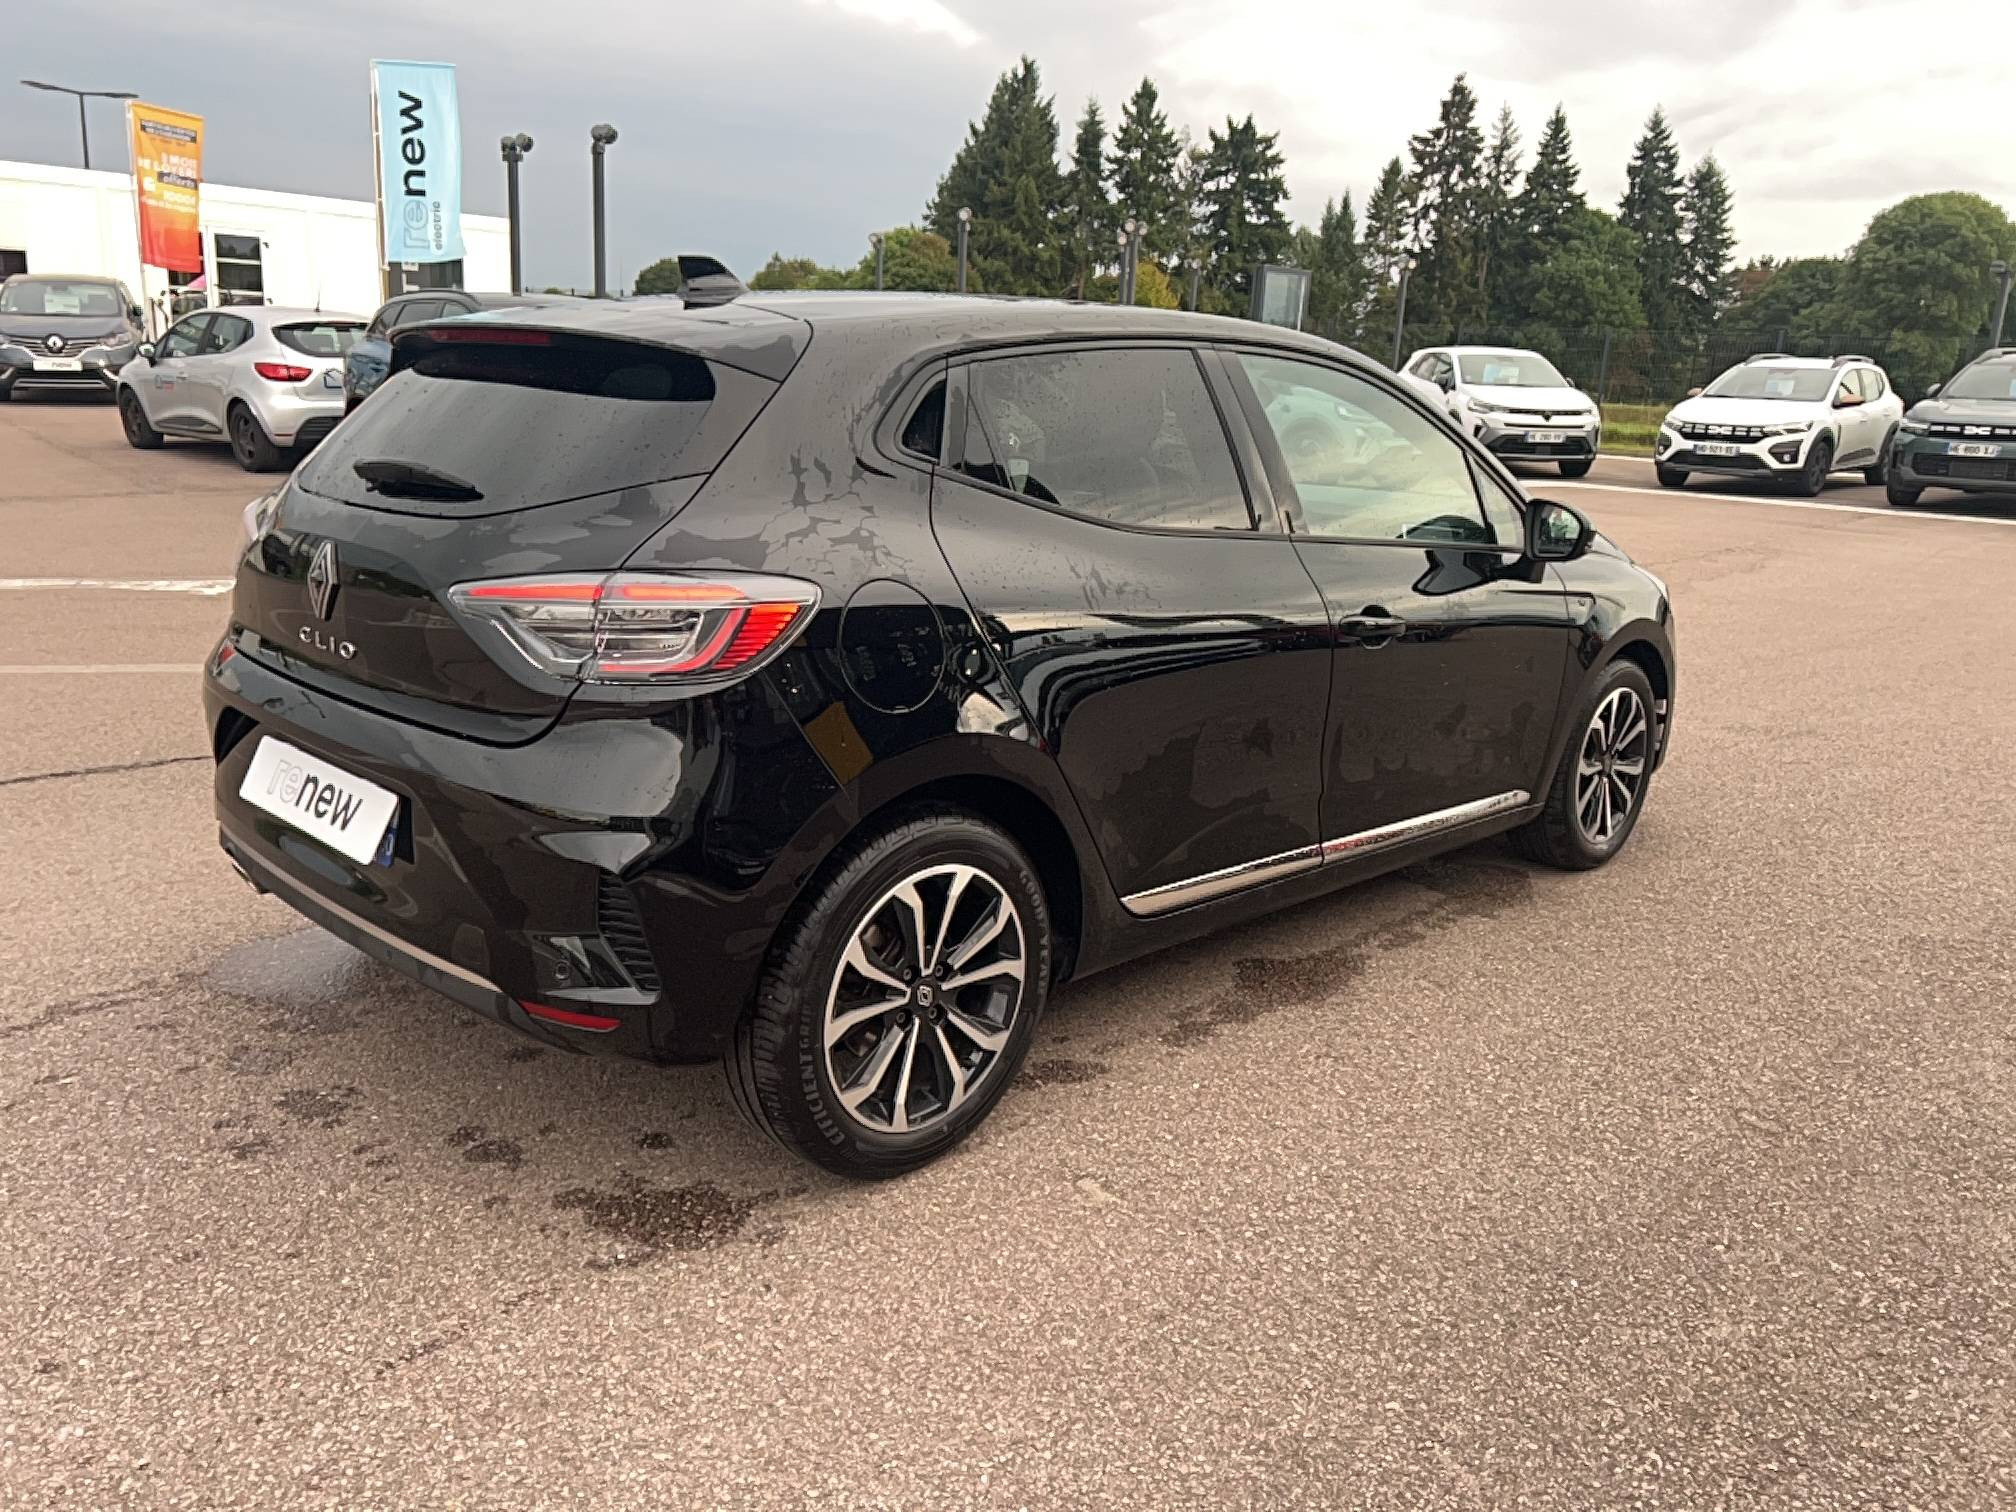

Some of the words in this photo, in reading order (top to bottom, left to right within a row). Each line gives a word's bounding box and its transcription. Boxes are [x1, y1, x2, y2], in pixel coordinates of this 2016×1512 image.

[397, 90, 430, 249] renew
[431, 200, 443, 250] electric
[298, 625, 357, 661] CLIO
[266, 759, 364, 832] renew
